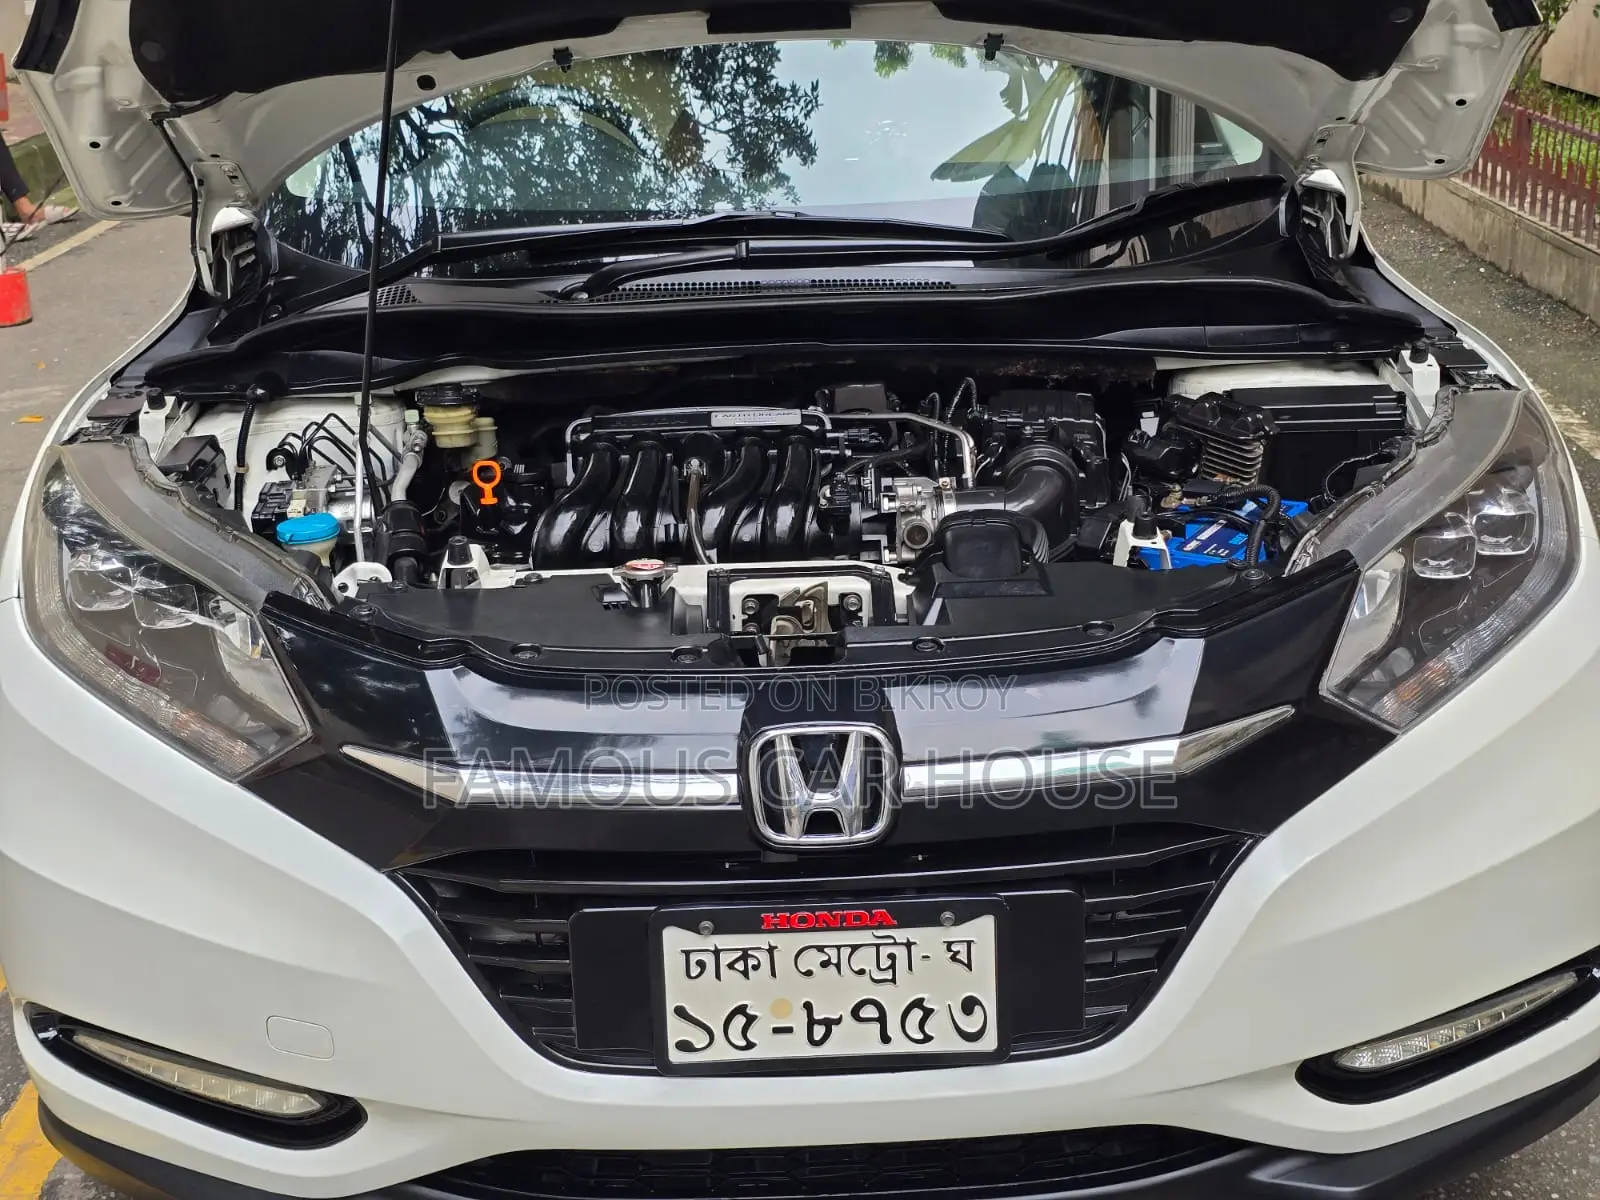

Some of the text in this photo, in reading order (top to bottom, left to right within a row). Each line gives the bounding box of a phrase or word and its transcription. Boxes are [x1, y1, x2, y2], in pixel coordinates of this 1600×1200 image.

[761, 909, 897, 930] HONDA
[680, 942, 779, 982] ঢাকা
[943, 939, 975, 972] ঘ
[673, 994, 989, 1053] ১৫-৮৭৫৩
